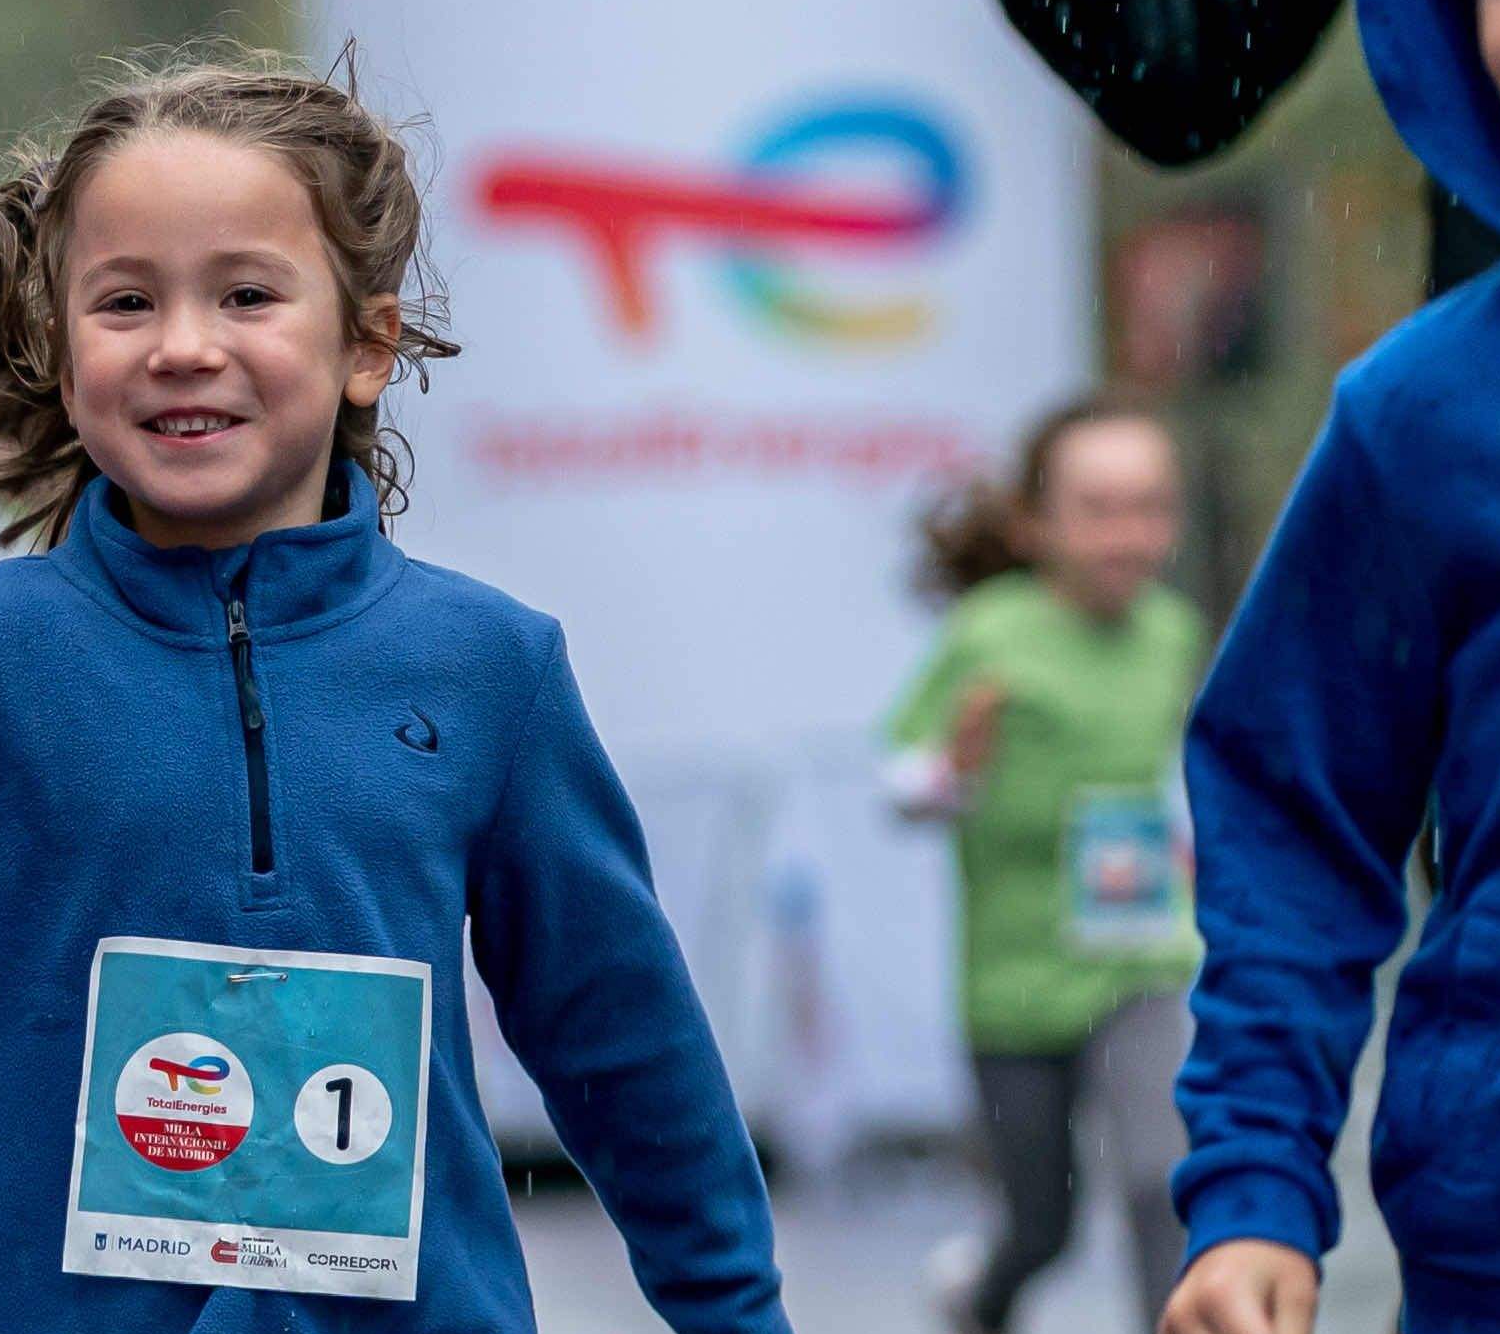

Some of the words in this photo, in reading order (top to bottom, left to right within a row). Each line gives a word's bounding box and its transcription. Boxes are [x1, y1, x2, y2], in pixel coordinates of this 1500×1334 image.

[146, 1097, 228, 1116] TotalEnergies
[325, 1077, 353, 1151] 1
[163, 1123, 203, 1137] MILLA
[147, 1145, 165, 1158] DE
[167, 1148, 216, 1163] MADRID
[118, 1236, 192, 1256] MADRID
